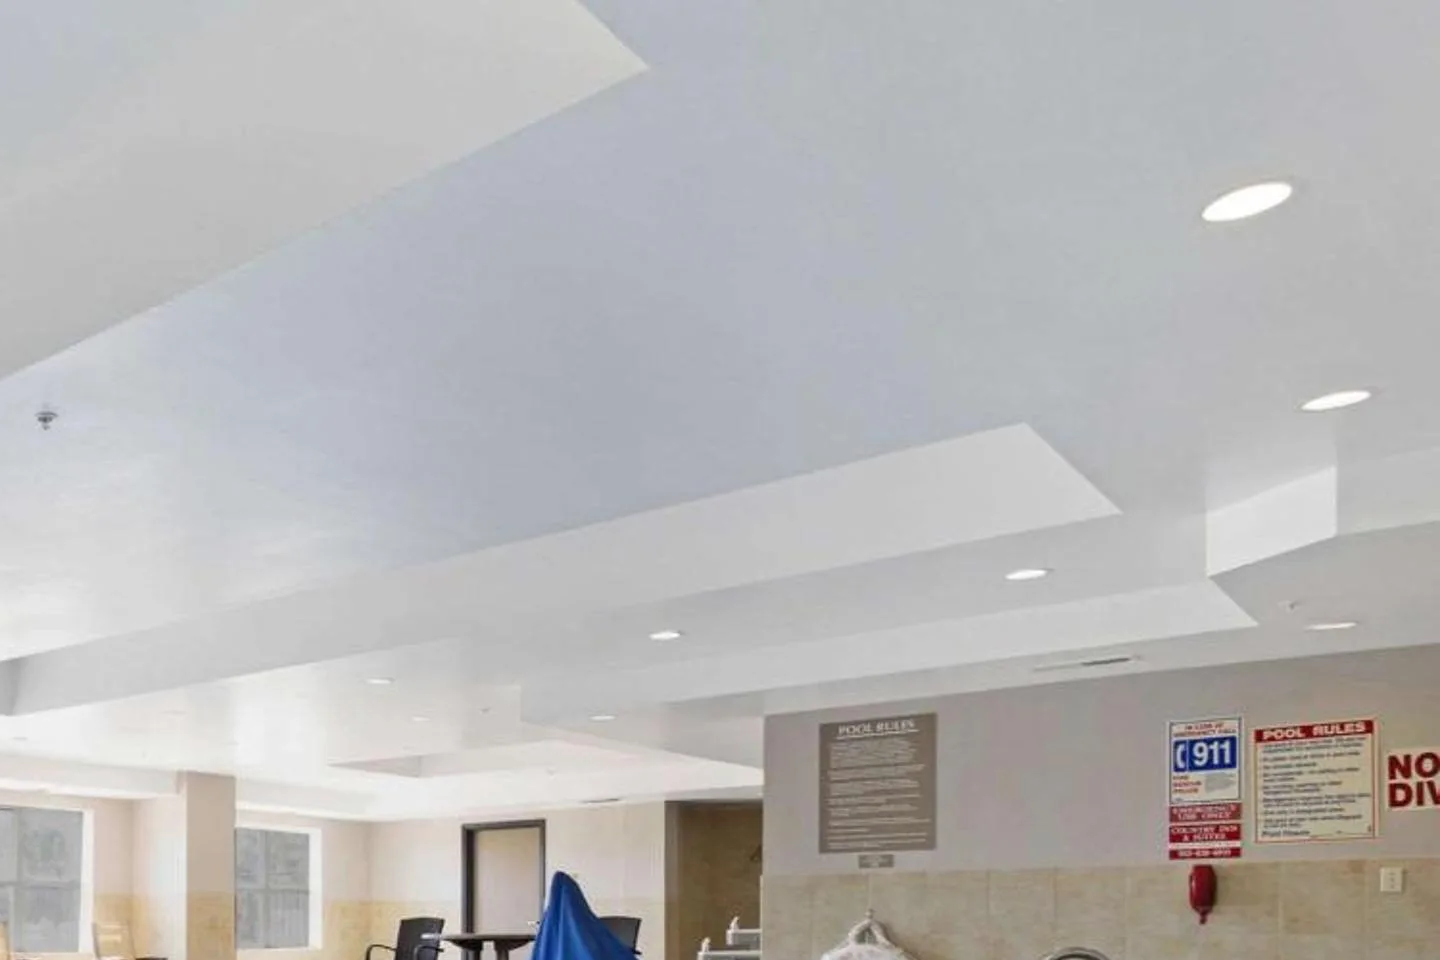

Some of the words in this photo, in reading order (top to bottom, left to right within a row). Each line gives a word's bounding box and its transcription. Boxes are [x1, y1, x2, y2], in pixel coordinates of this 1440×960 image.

[838, 723, 873, 735] POOL
[876, 719, 916, 732] RULES
[1262, 728, 1305, 740] POOL
[1312, 722, 1366, 737] RULES
[1192, 740, 1231, 767] 911
[1388, 752, 1440, 779] NO
